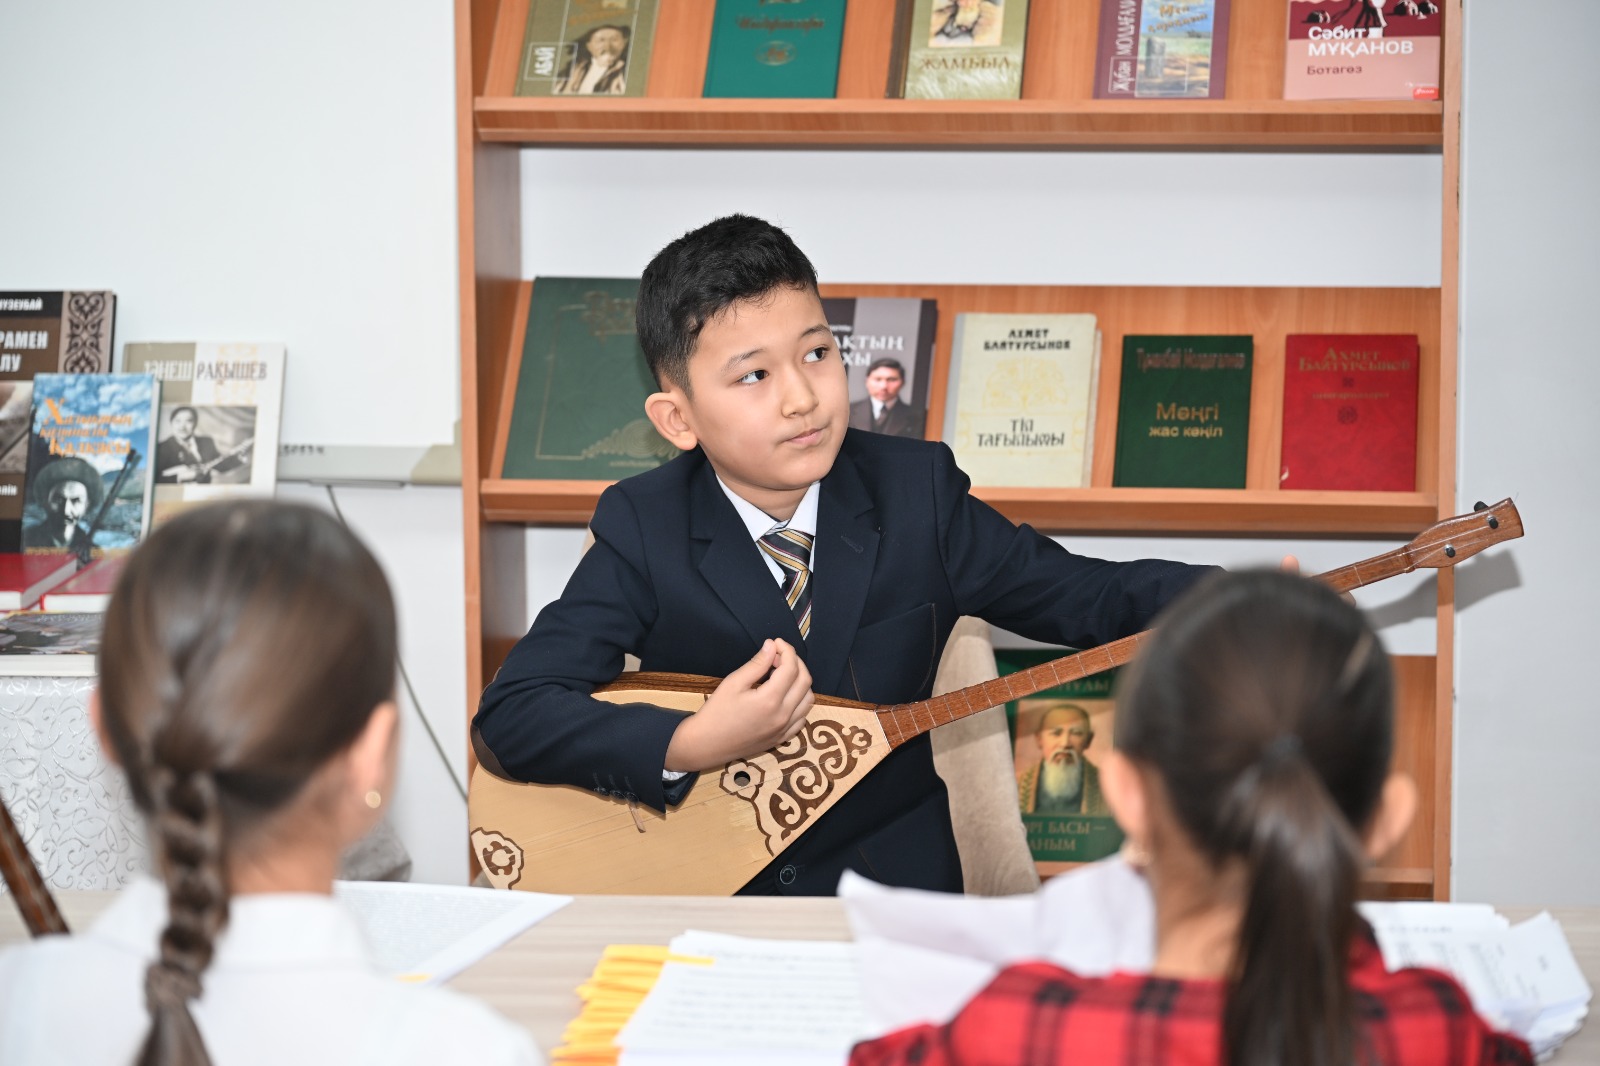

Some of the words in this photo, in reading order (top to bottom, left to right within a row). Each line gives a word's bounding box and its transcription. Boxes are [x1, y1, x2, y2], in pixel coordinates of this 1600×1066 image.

[1308, 25, 1366, 40] Сәбит
[1308, 40, 1414, 57] МҰҚАНОВ
[534, 46, 556, 76] АБАЙ
[920, 56, 1010, 70] ЖАМБЫЛ
[1307, 65, 1363, 75] Ботагөз
[1048, 821, 1091, 834] БАСЫ
